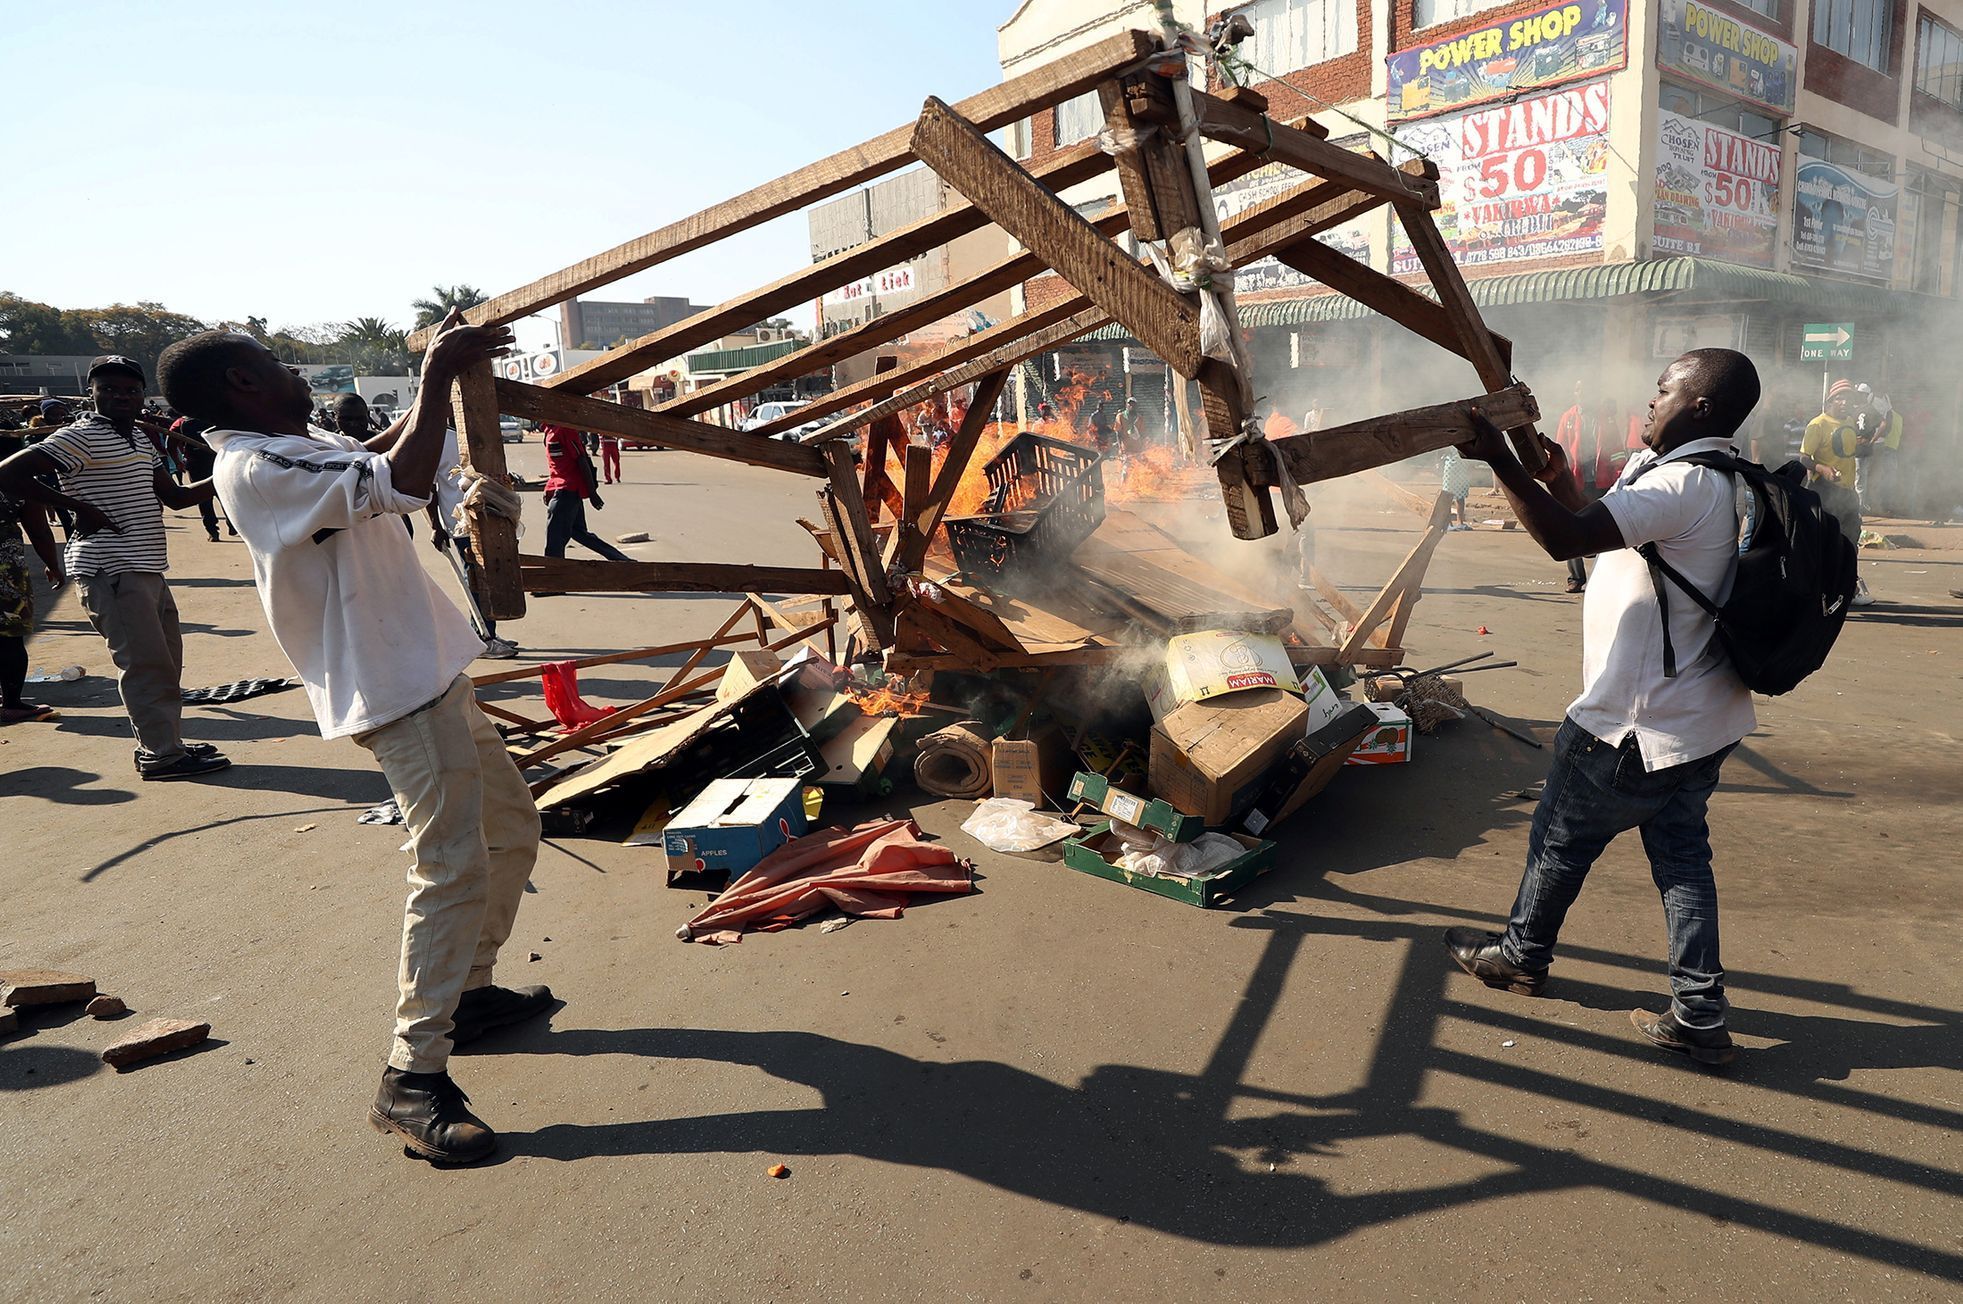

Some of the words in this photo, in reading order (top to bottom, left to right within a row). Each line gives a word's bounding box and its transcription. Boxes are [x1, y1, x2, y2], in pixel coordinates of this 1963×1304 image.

[1419, 28, 1503, 75] POWER
[1509, 5, 1582, 50] SHOP
[1684, 2, 1741, 53] POWER
[1742, 29, 1779, 68] SHOP
[1463, 85, 1608, 159] STANDS
[1661, 134, 1700, 151] CHOSEN
[1705, 130, 1780, 184] STANDS
[1457, 162, 1482, 173] FROM
[1238, 190, 1258, 203] CASH
[1652, 235, 1684, 250] SUITE
[1804, 350, 1823, 358] ONE
[1830, 349, 1850, 357] WAY
[1229, 676, 1275, 688] MARIAM
